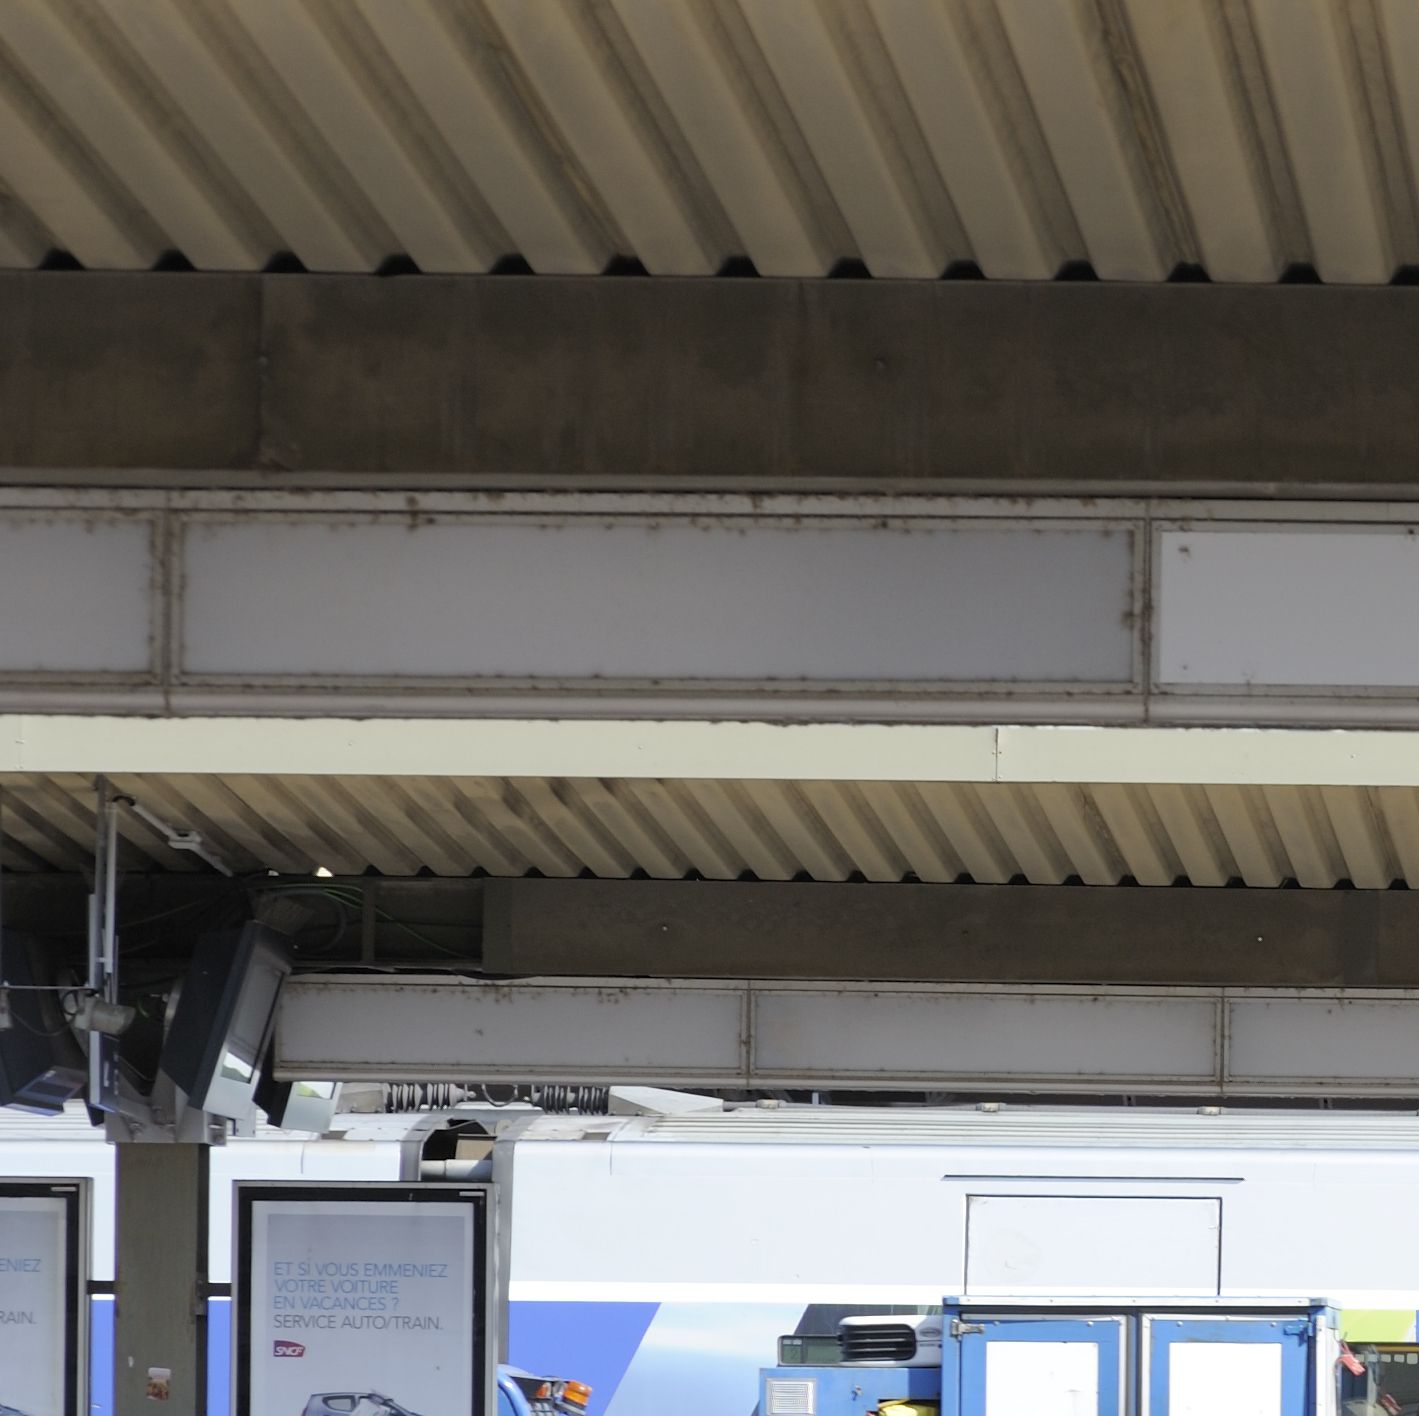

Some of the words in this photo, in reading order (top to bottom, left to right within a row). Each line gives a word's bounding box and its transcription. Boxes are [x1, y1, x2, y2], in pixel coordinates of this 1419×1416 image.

[273, 1261, 293, 1276] ET
[298, 1261, 310, 1276] SI
[315, 1262, 359, 1277] VOUS
[364, 1263, 449, 1279] EMMENIEZ
[273, 1279, 326, 1294] VOTRE
[330, 1280, 399, 1295] VOITURE
[273, 1296, 295, 1310] EN
[300, 1296, 386, 1311] VACANCES
[273, 1315, 336, 1329] SERVICE
[340, 1315, 444, 1330] AUTO/TRAIN.
[274, 1346, 304, 1356] SNCF
